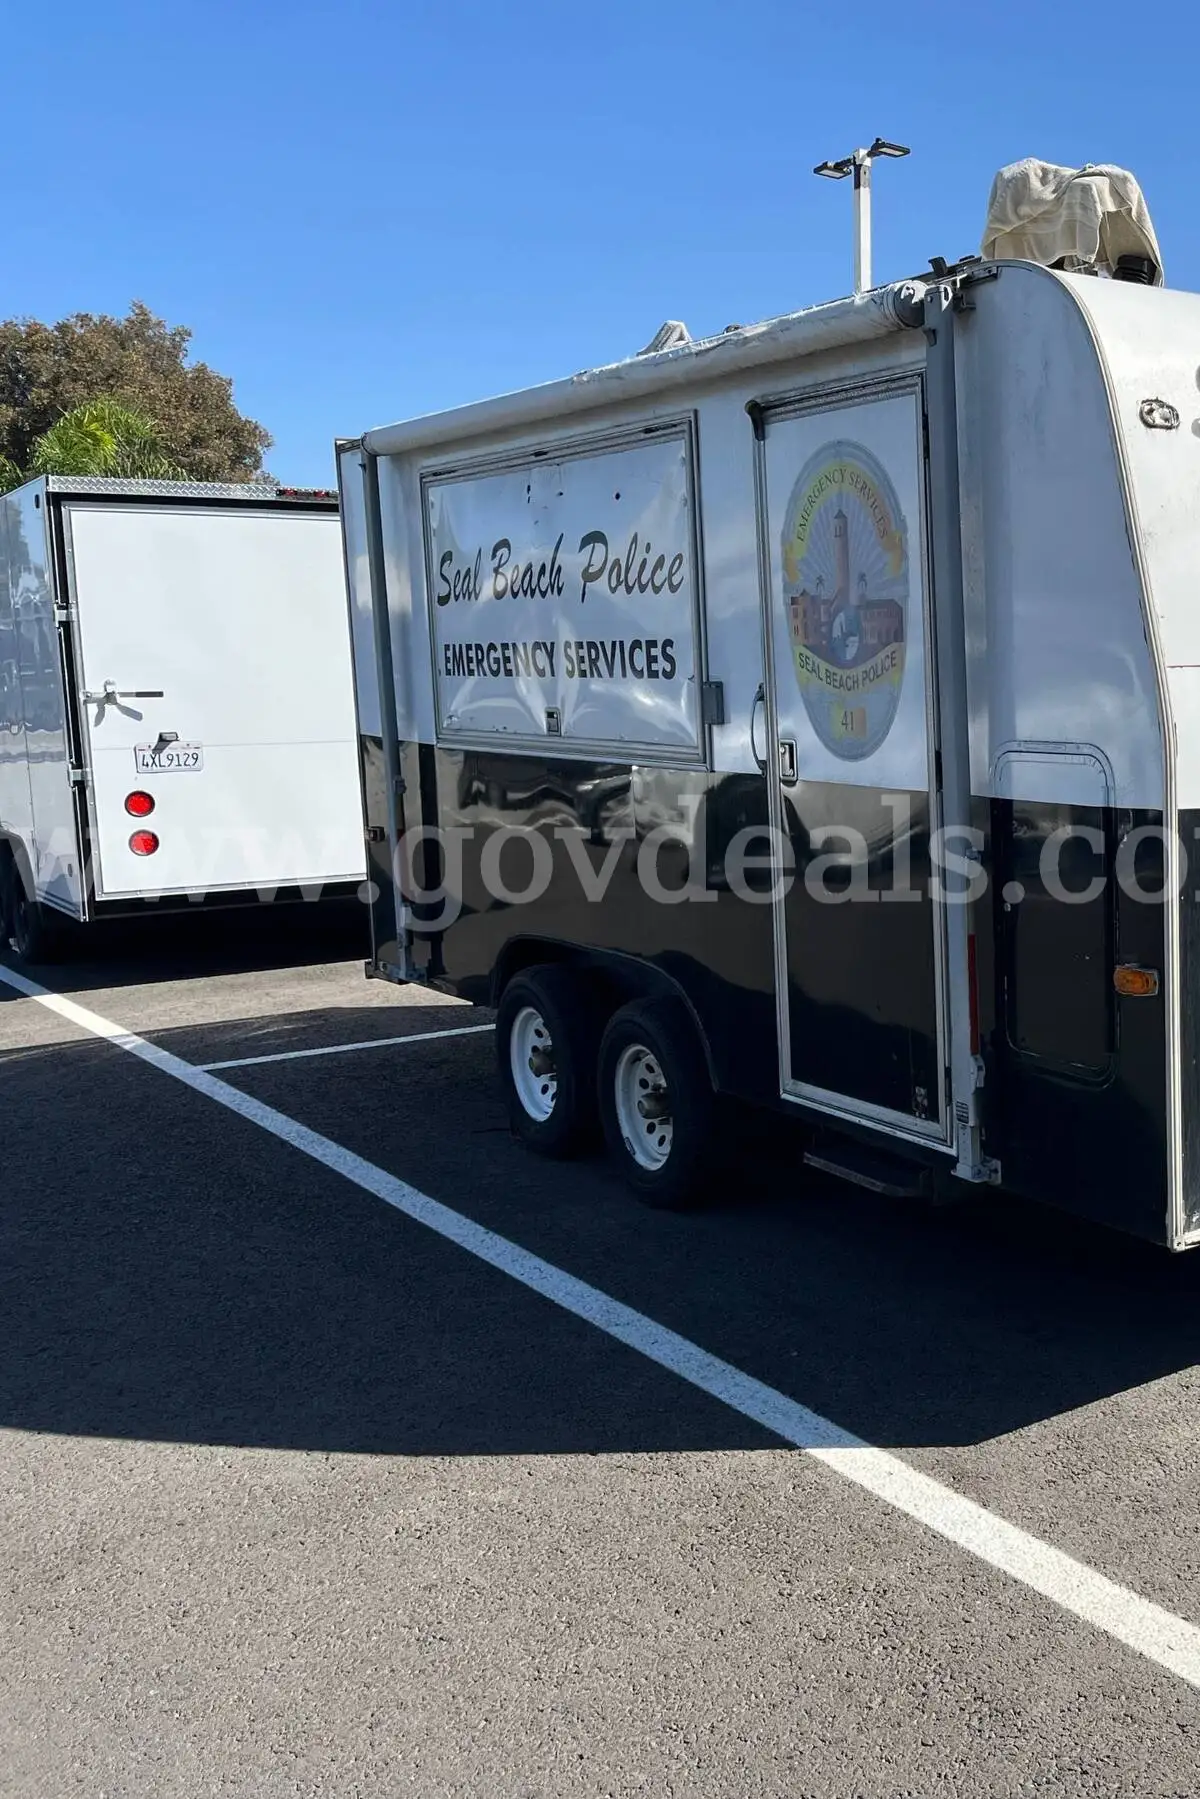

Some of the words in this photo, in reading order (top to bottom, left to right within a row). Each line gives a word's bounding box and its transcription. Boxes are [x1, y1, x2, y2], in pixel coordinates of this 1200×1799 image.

[797, 468, 847, 542] EMERGENCY
[849, 471, 888, 539] SERVICES
[436, 548, 483, 607] Seal
[491, 533, 565, 600] Beach
[578, 530, 686, 602] Police
[444, 641, 556, 679] EMERGENCY
[563, 637, 677, 680] SERVICES
[798, 652, 824, 681] SEAL
[825, 668, 859, 692] BEACH
[861, 650, 897, 688] POLICE
[841, 711, 854, 732] 41
[142, 752, 199, 768] 4XL9129
